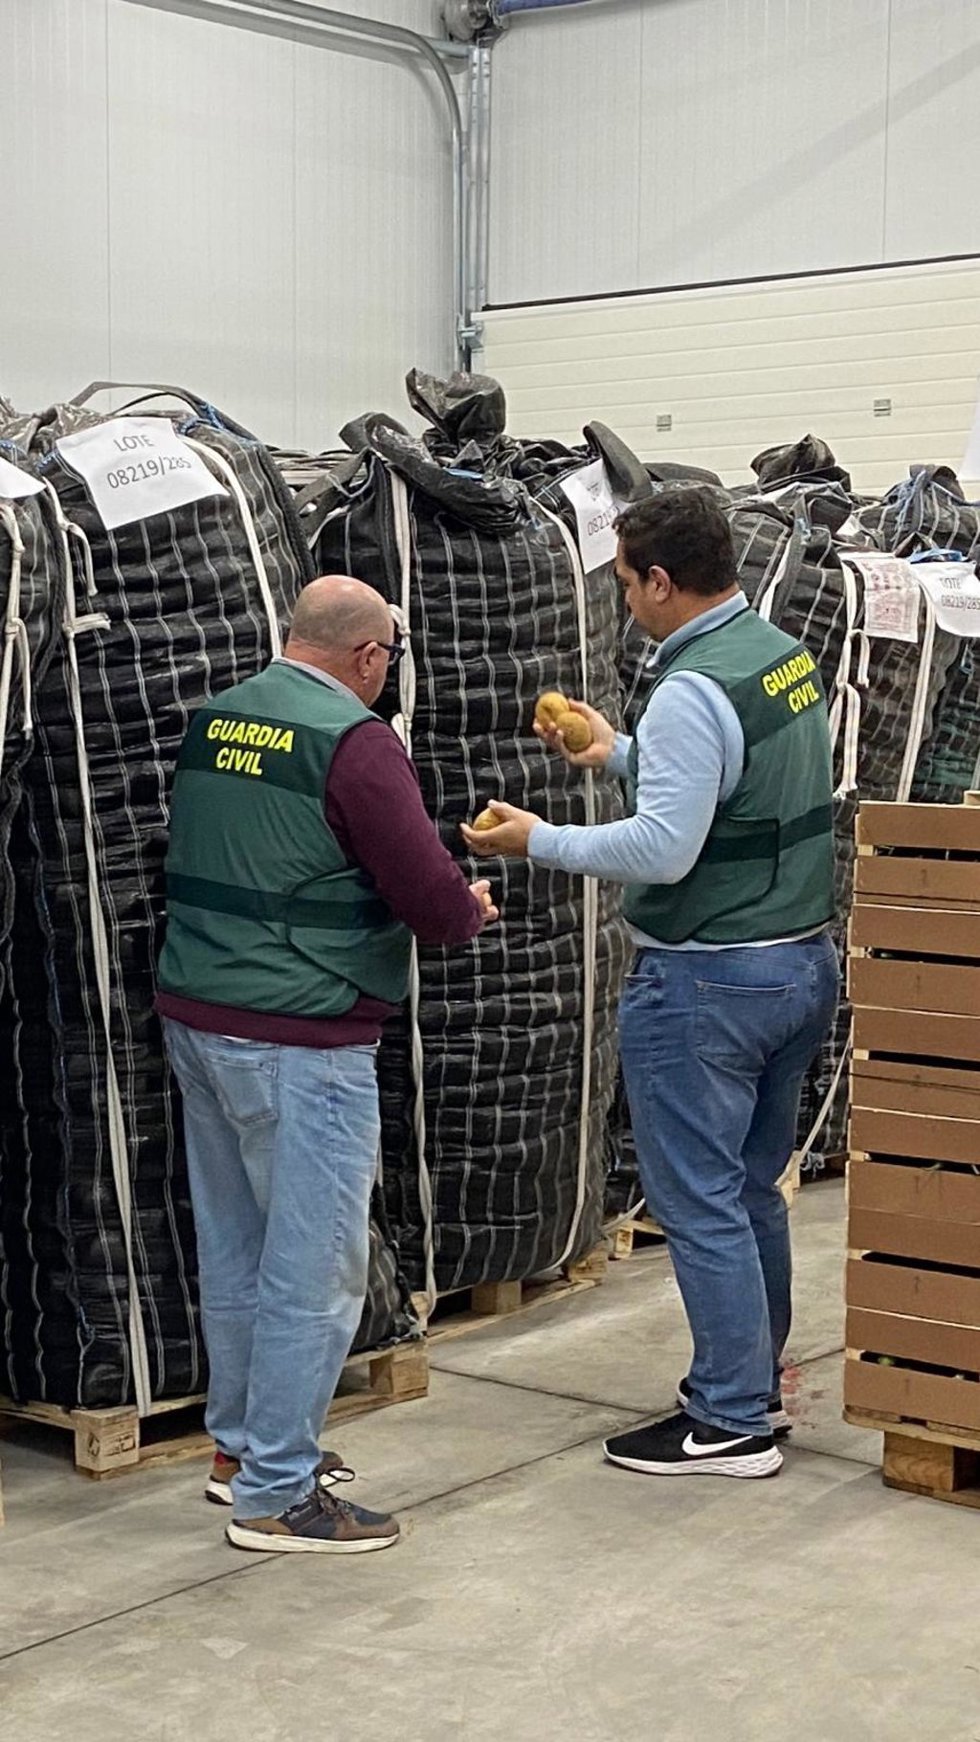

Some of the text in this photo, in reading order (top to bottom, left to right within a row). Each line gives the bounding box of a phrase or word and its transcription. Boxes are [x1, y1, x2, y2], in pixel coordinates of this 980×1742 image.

[113, 435, 155, 451] LOTE
[762, 650, 816, 697] GUARDIA
[788, 680, 820, 714] CIVIL
[207, 719, 294, 753] GUARDIA
[216, 747, 263, 776] CIVIL
